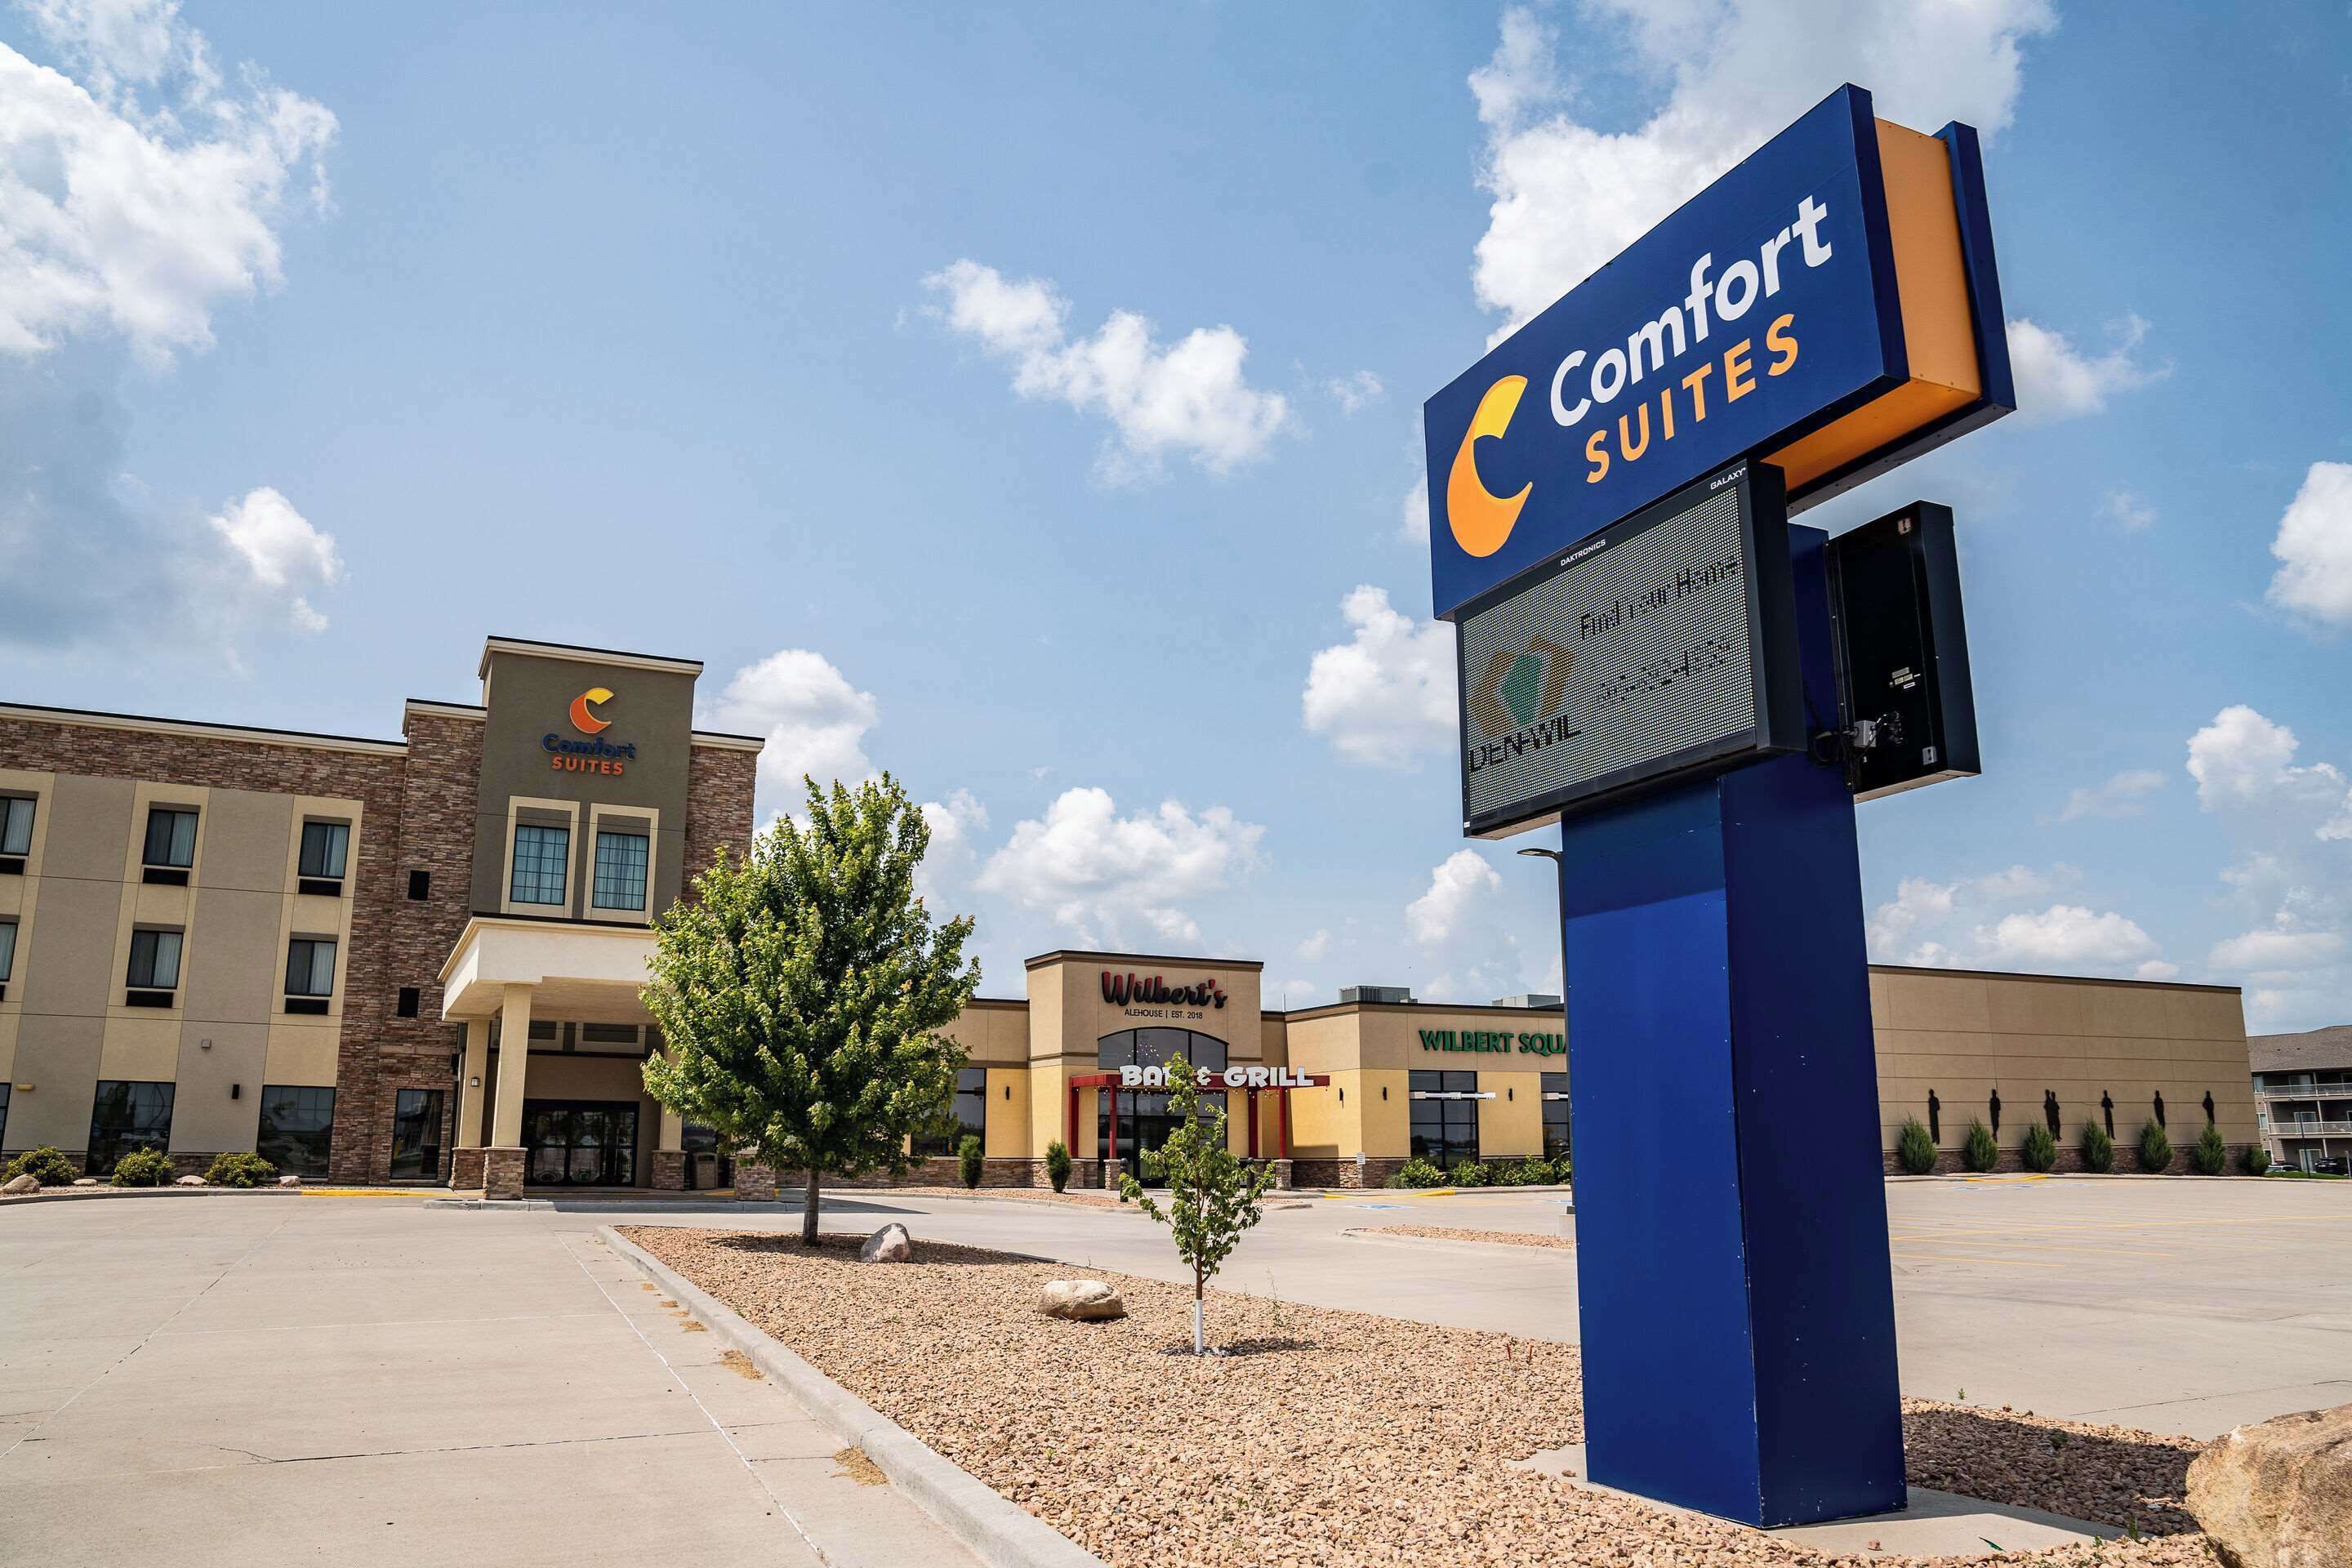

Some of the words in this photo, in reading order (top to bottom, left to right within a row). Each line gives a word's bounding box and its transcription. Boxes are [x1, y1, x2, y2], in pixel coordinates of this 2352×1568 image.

[1550, 195, 1833, 427] Comfort
[1585, 314, 1799, 483] SUITES
[1561, 539, 1606, 567] DAKTRONICS
[542, 733, 636, 761] Comfort
[551, 756, 623, 776] SUITES
[1102, 971, 1228, 1009] Wilbert's
[1124, 1009, 1163, 1018] ALEHOUSE
[1171, 1010, 1184, 1018] EST.
[1187, 1011, 1203, 1019] 2018
[1419, 1030, 1514, 1053] WILBERT
[1518, 1032, 1567, 1057] SQU
[1223, 1066, 1314, 1088] GRILL
